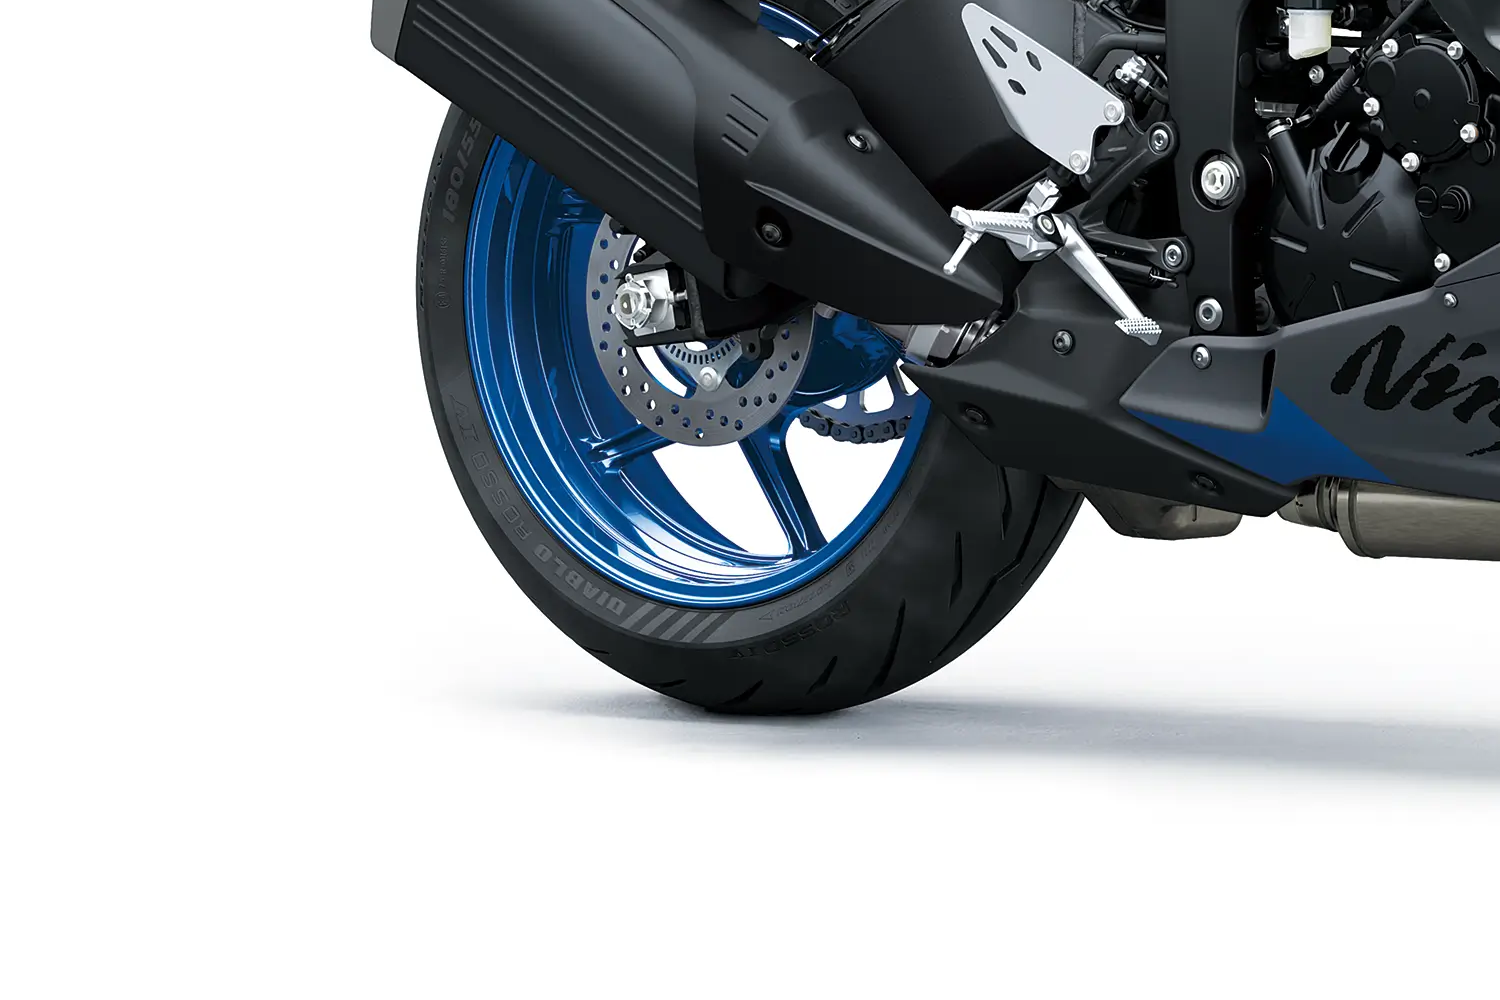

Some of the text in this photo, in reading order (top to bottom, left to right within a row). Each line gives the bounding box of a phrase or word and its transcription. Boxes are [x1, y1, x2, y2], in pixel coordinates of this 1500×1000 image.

[442, 116, 483, 223] 180/55
[448, 393, 627, 616] DIABLO ROSSO IV
[763, 600, 852, 654] ROSSO
